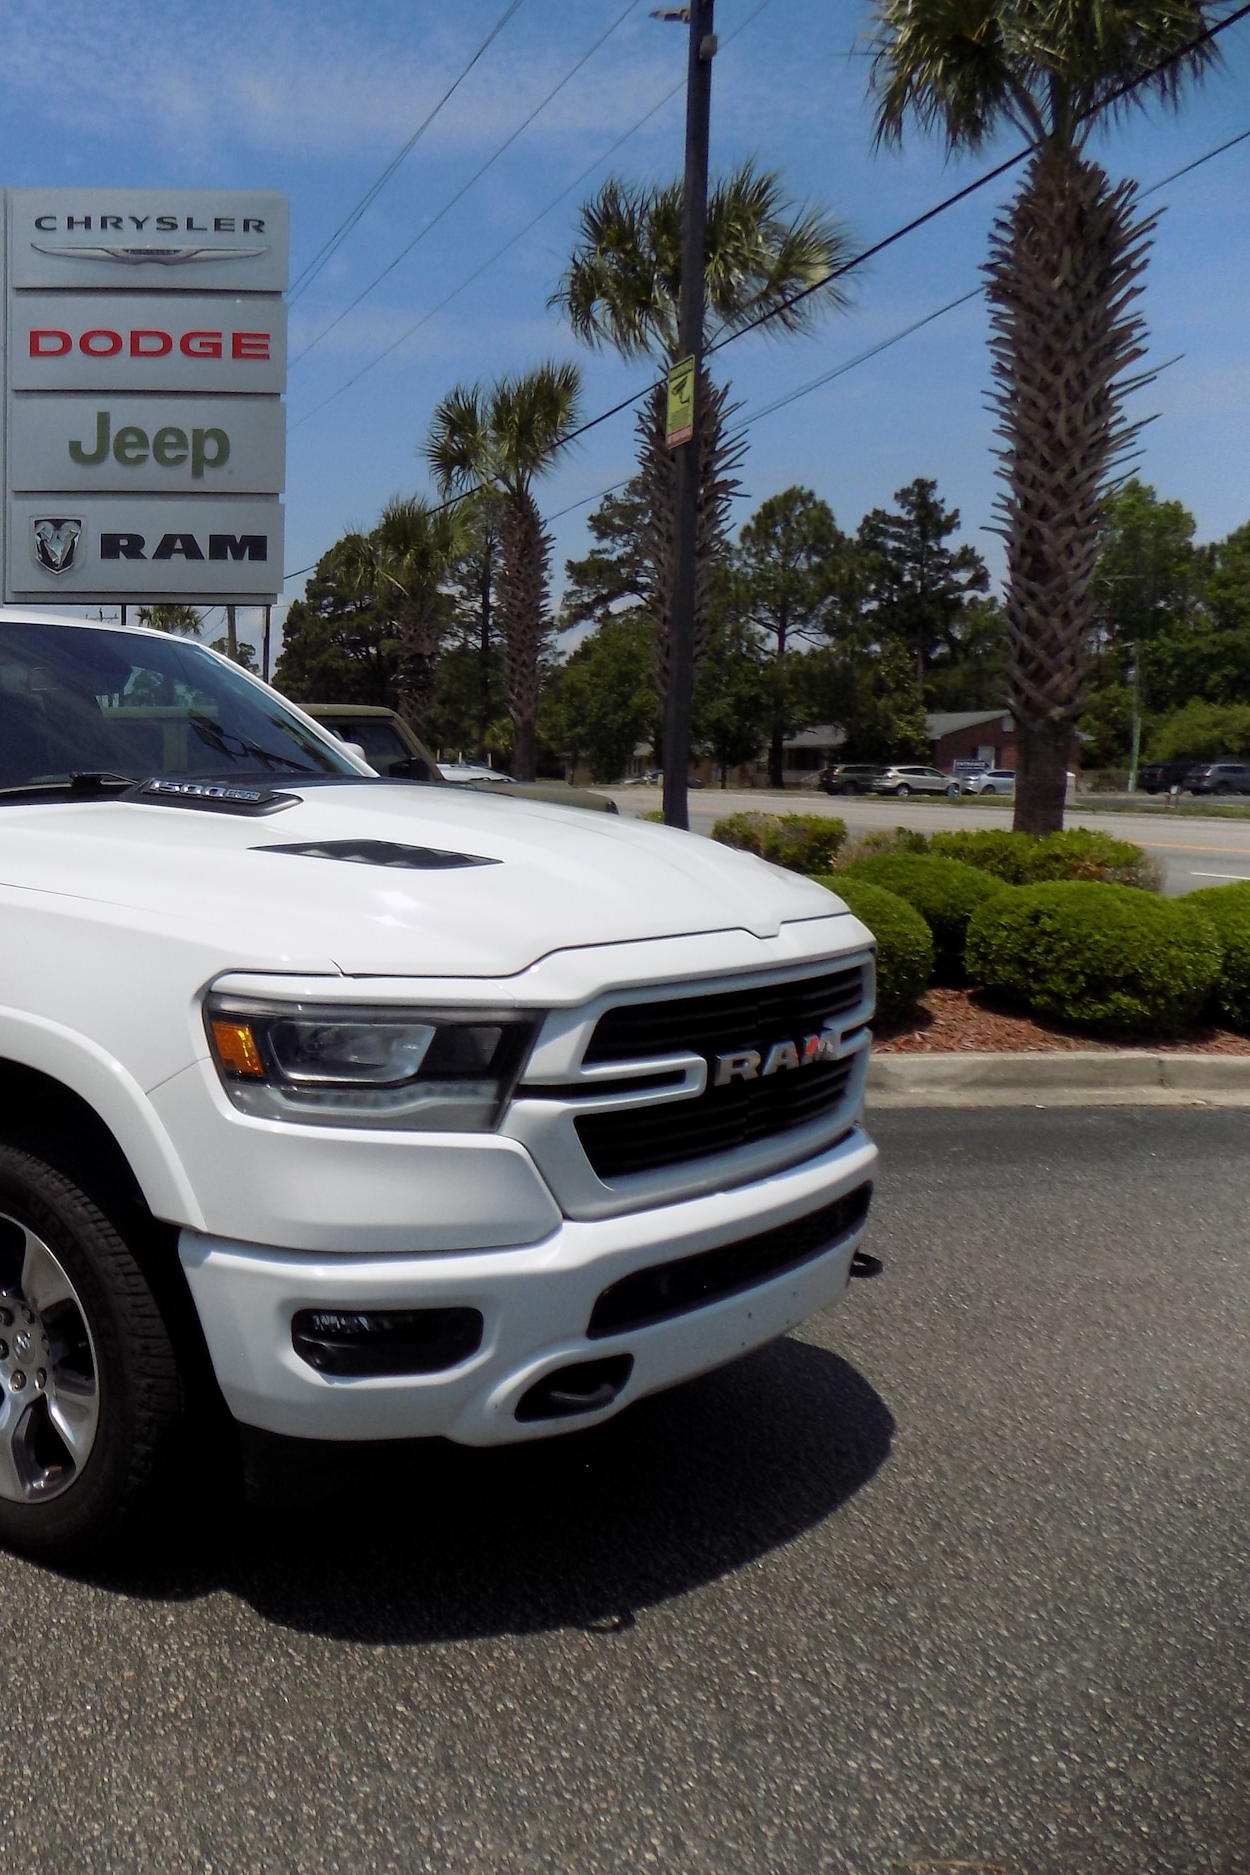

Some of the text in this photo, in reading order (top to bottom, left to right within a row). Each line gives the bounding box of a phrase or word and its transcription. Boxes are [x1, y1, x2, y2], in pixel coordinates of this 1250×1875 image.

[34, 215, 266, 234] CHRYSLER
[29, 329, 271, 360] DODGE
[68, 411, 232, 479] Jeep
[100, 533, 268, 562] RAM
[149, 778, 225, 797] 1500
[713, 1029, 836, 1087] RAM
